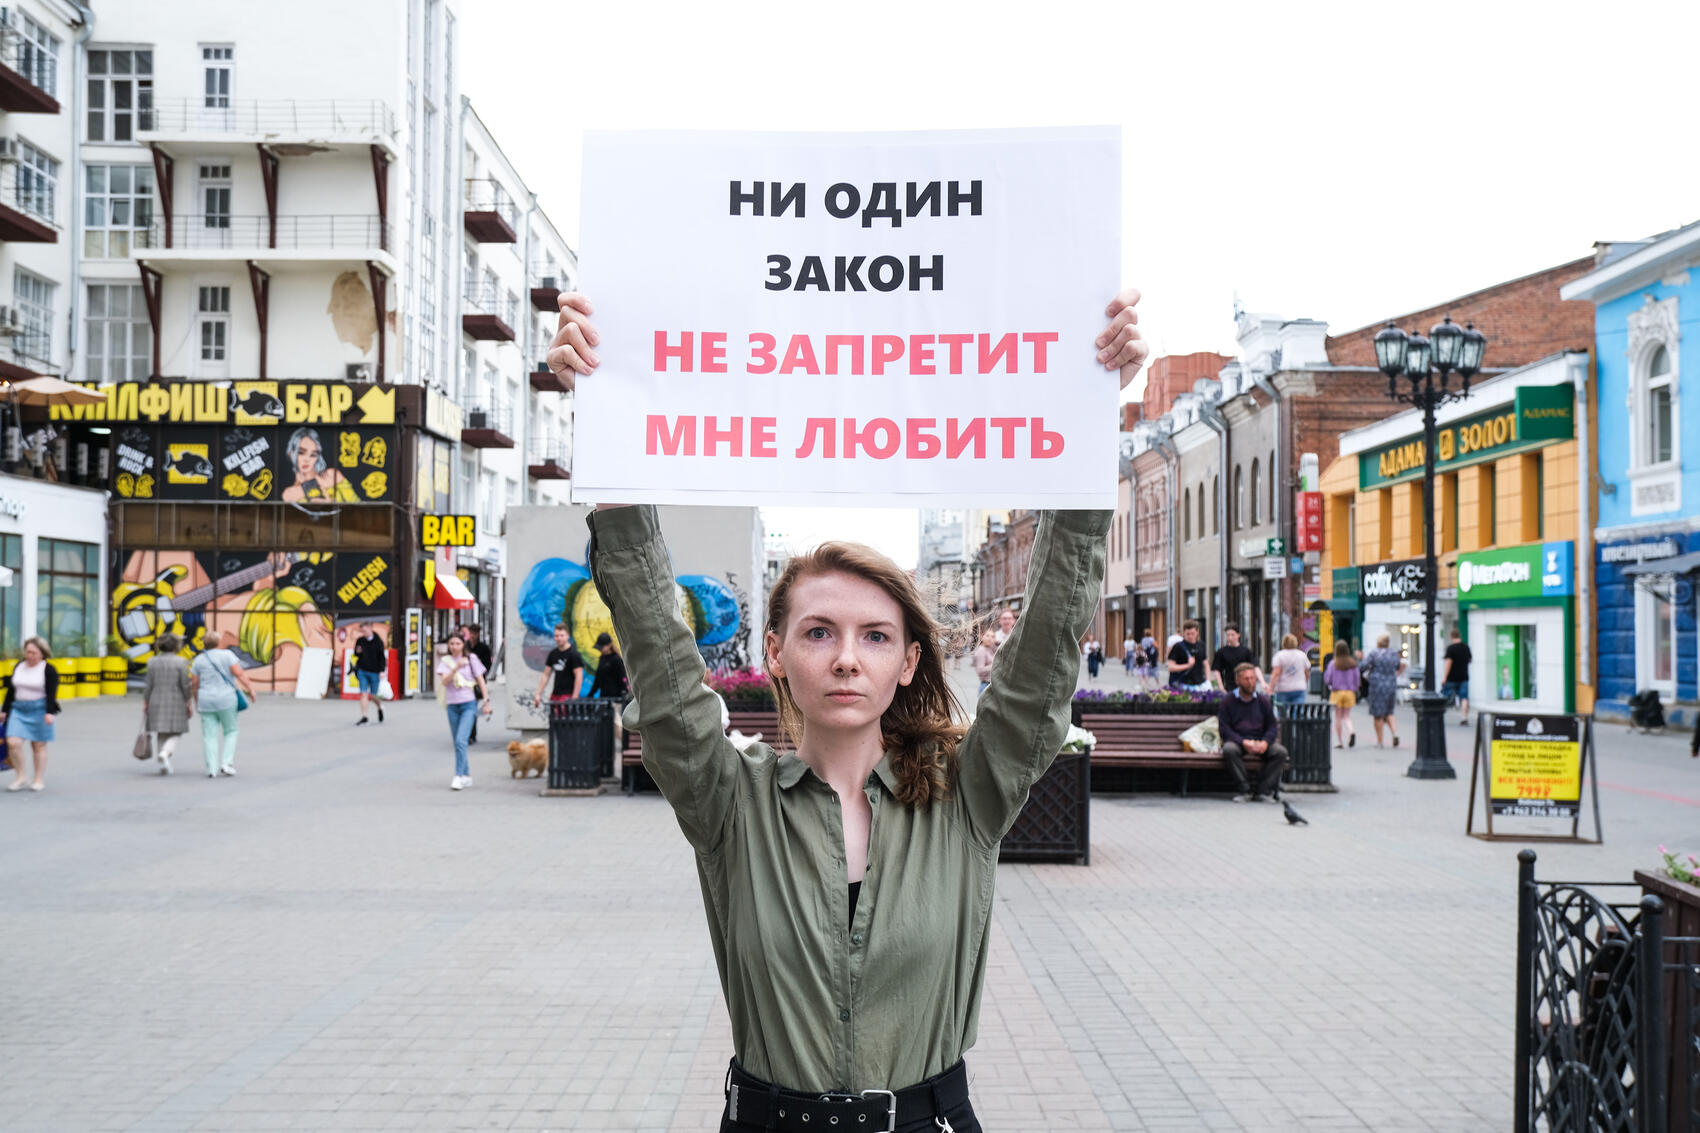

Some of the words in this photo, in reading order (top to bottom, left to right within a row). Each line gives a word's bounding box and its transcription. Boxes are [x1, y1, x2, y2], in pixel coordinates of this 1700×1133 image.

[729, 180, 806, 218] НИ
[824, 180, 983, 229] ОДИН
[764, 254, 945, 292] ЗАКОН
[653, 330, 727, 374] НЕ
[746, 331, 1059, 376] ЗАПРЕТИТ
[286, 384, 353, 423] БАР
[116, 443, 146, 465] DRINK
[222, 436, 270, 472] KILLFISH
[645, 414, 777, 458] МНЕ
[795, 416, 1066, 460] ЛЮБИТЬ
[118, 456, 146, 476] ROCK
[240, 455, 266, 477] BAR
[1378, 440, 1425, 477] АДАМА
[422, 515, 474, 546] BAR
[337, 556, 388, 604] KILLFISH
[359, 579, 387, 606] BAR
